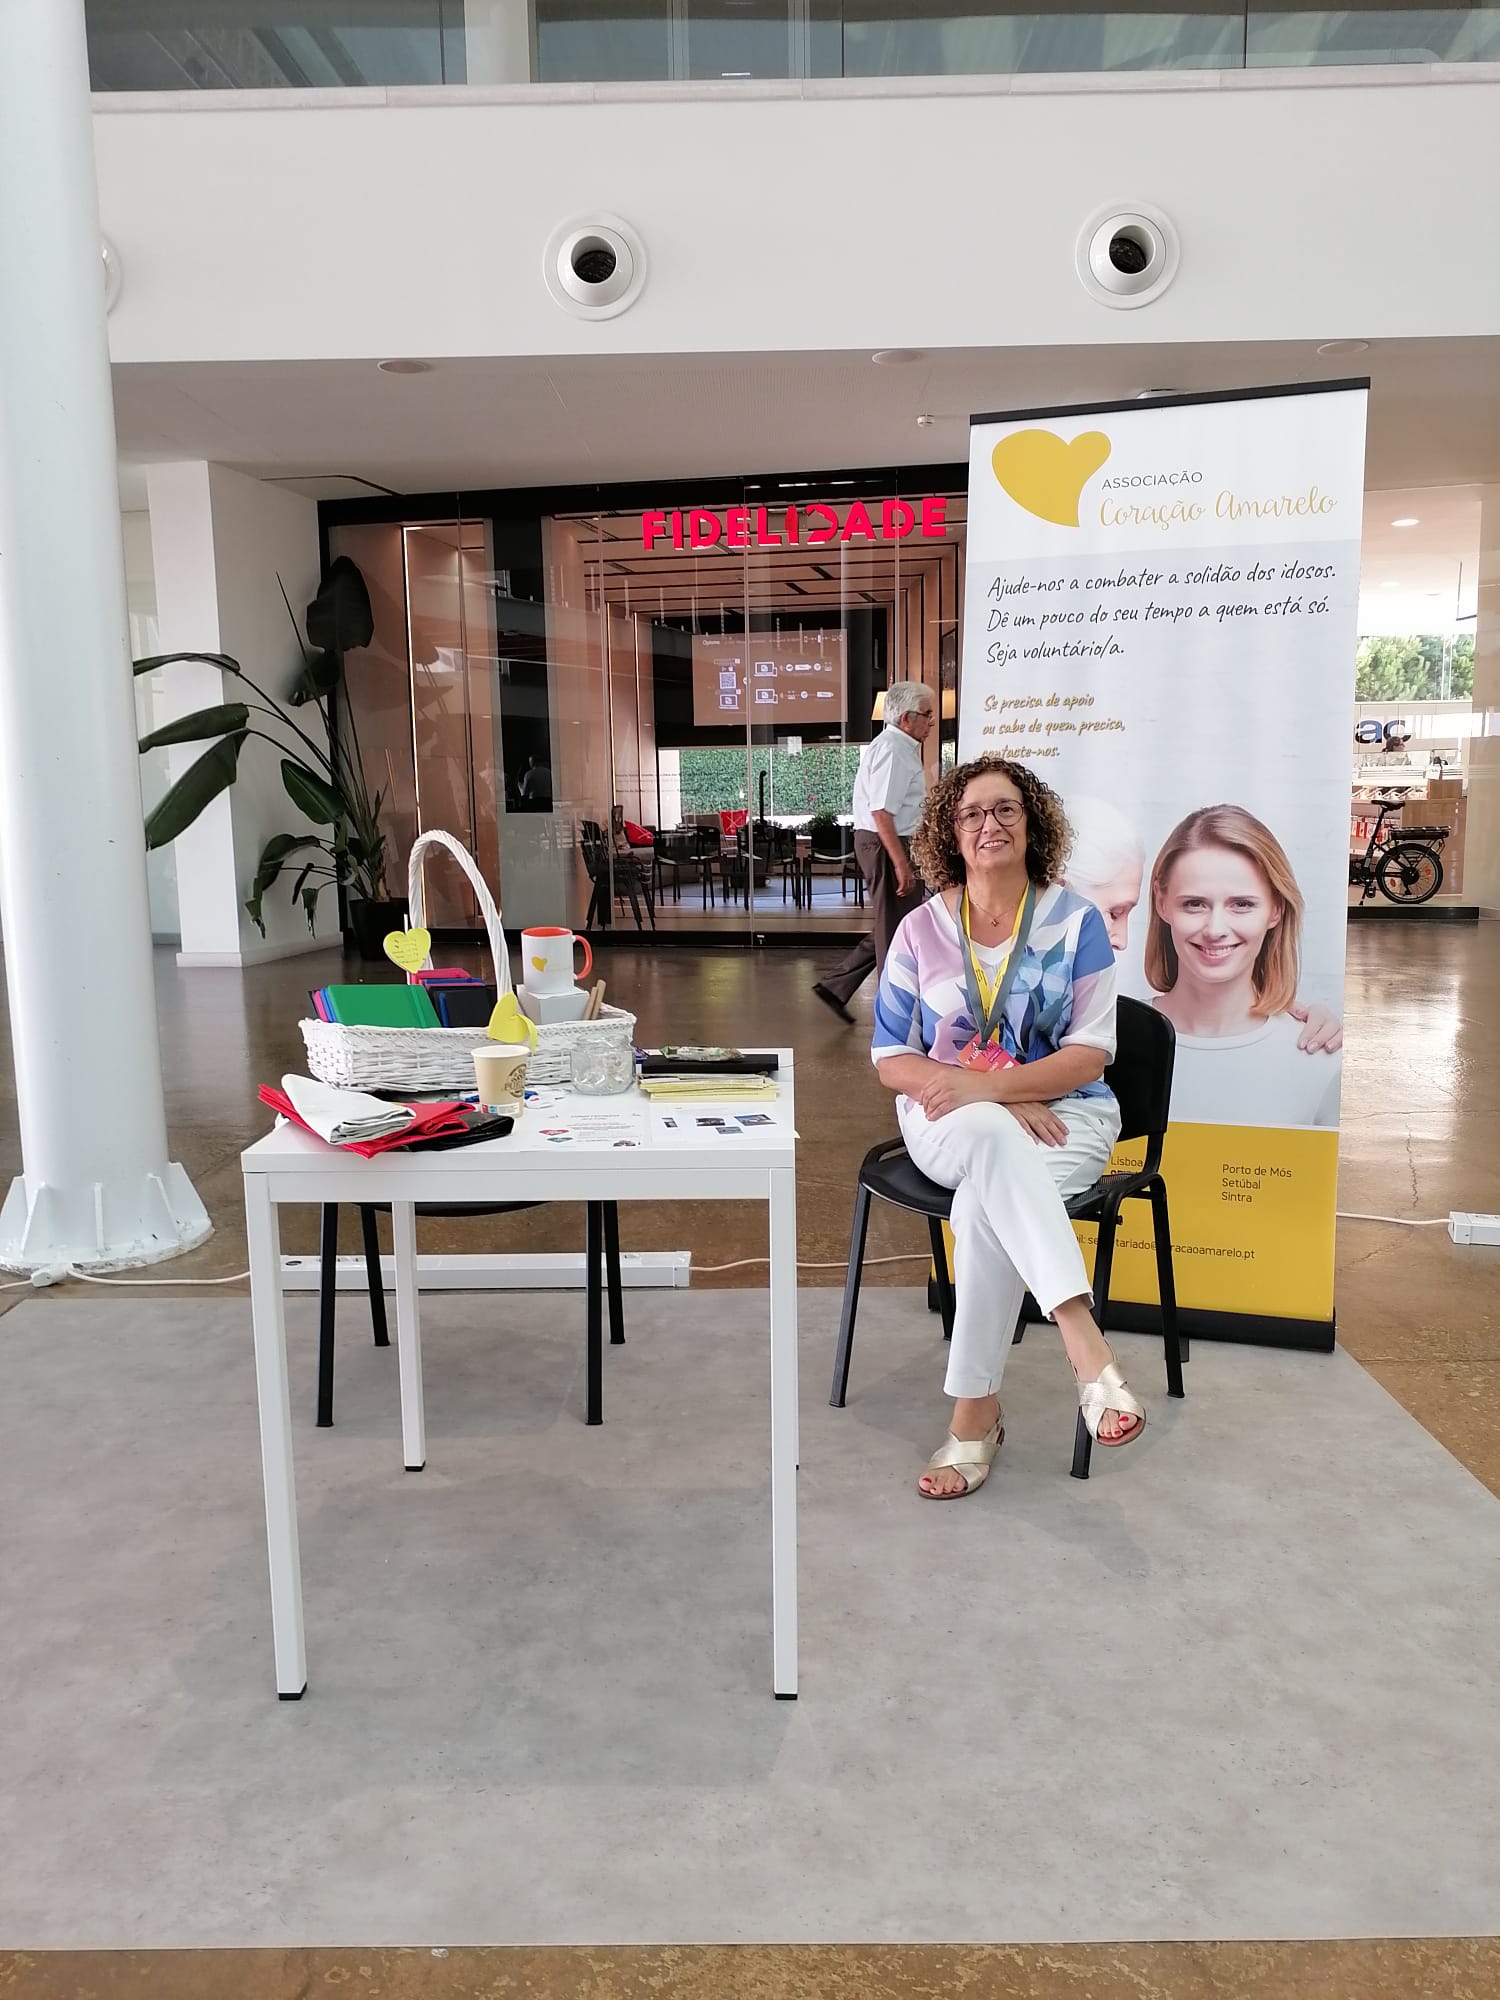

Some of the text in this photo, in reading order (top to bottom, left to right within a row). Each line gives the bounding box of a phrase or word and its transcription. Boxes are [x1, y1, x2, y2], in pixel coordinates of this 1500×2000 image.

[1101, 470, 1203, 490] ASSOCIAÇÃO
[1100, 486, 1338, 531] Coração Amarelo
[642, 497, 947, 550] FIDELIDADE
[987, 560, 1336, 601] Ajude-nos a combater a solidão dos idosos.
[987, 595, 1330, 632] Dê um pouco do seu tempo a quem está só.
[986, 635, 1125, 667] Seja voluntário/a.
[983, 692, 1095, 713] Se precisa de apoio
[982, 718, 1126, 737] ou sabe de quem precisa,
[1110, 1156, 1143, 1167] Lisboa
[1222, 1163, 1293, 1178] Porto de Mós
[1222, 1177, 1261, 1190] Setúbal
[1221, 1191, 1253, 1203] Sintra
